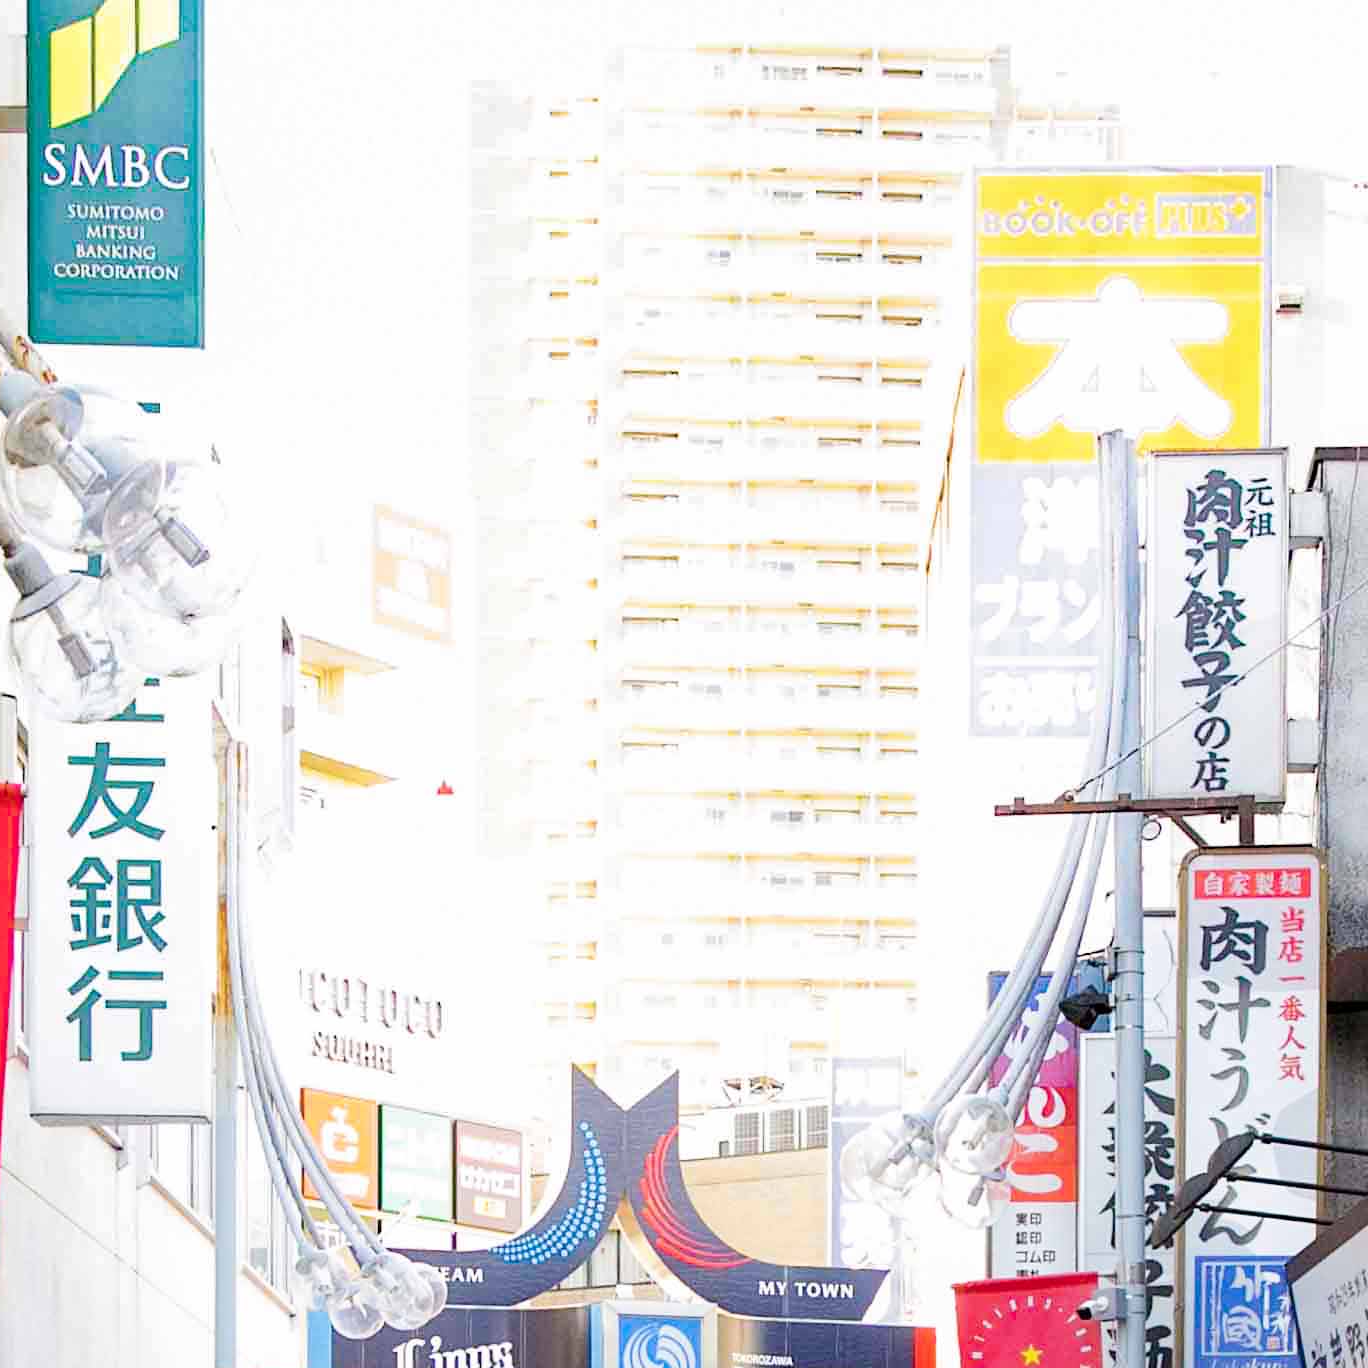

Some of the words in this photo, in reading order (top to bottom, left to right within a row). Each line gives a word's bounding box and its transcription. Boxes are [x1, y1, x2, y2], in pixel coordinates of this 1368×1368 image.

[42, 143, 189, 190] SMBC
[66, 204, 164, 221] SUMITOMO
[86, 223, 145, 241] MITSUI
[75, 244, 156, 260] BANKING
[53, 263, 179, 281] CORPORATION
[1006, 276, 1233, 439] 本
[1245, 478, 1277, 538] 元祖
[1177, 470, 1247, 792] 肉汁餃子の店
[1202, 870, 1304, 896] 自家製麺
[1276, 906, 1307, 1083] 当店一番人気
[758, 1281, 787, 1296] MY
[794, 1282, 854, 1298] TOWN
